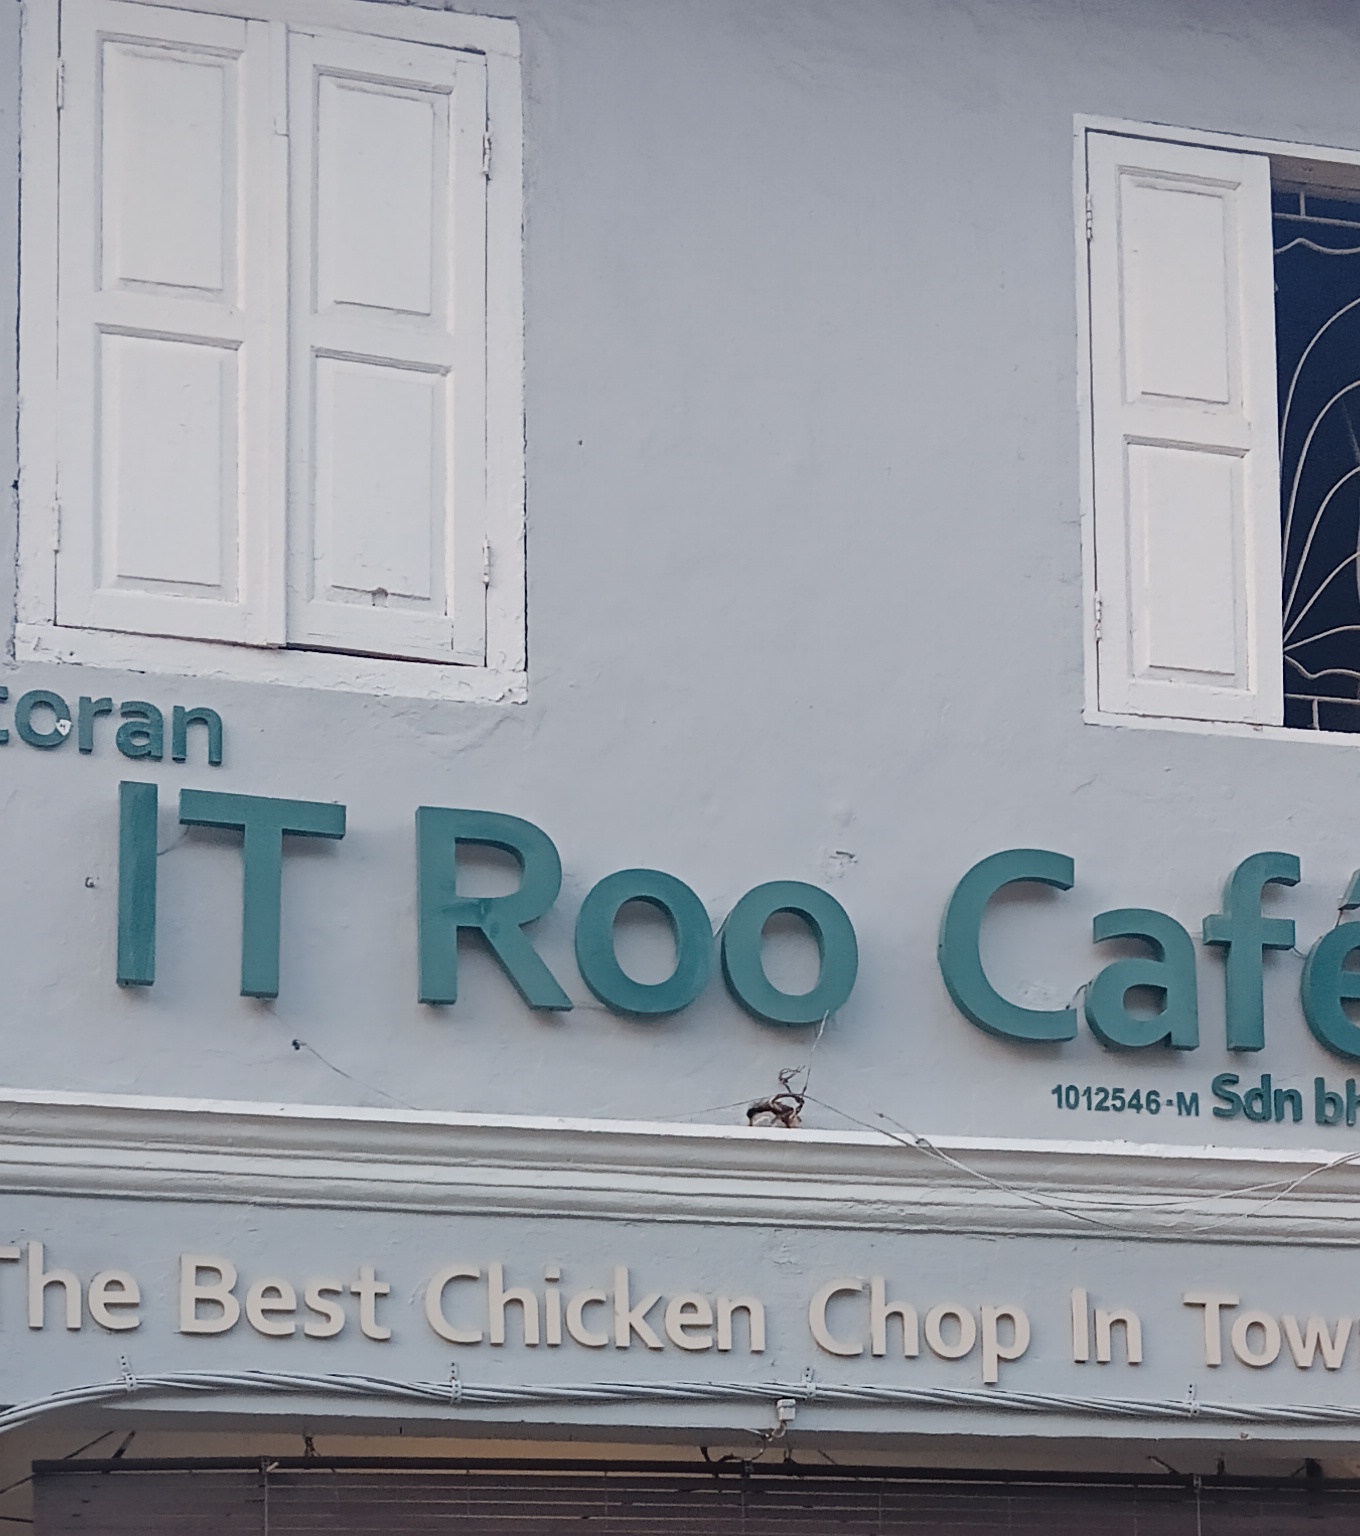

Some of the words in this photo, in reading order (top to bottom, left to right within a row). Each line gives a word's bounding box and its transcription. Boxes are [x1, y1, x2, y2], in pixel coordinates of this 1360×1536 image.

[116, 780, 347, 998] IT
[415, 805, 858, 1025] Roo
[1051, 1083, 1200, 1118] 1012546-M
[1211, 1072, 1303, 1123] Sdn
[178, 1253, 392, 1341] Best
[426, 1261, 766, 1352] Chicken
[808, 1275, 1031, 1385] Chop
[1071, 1287, 1143, 1365] In
